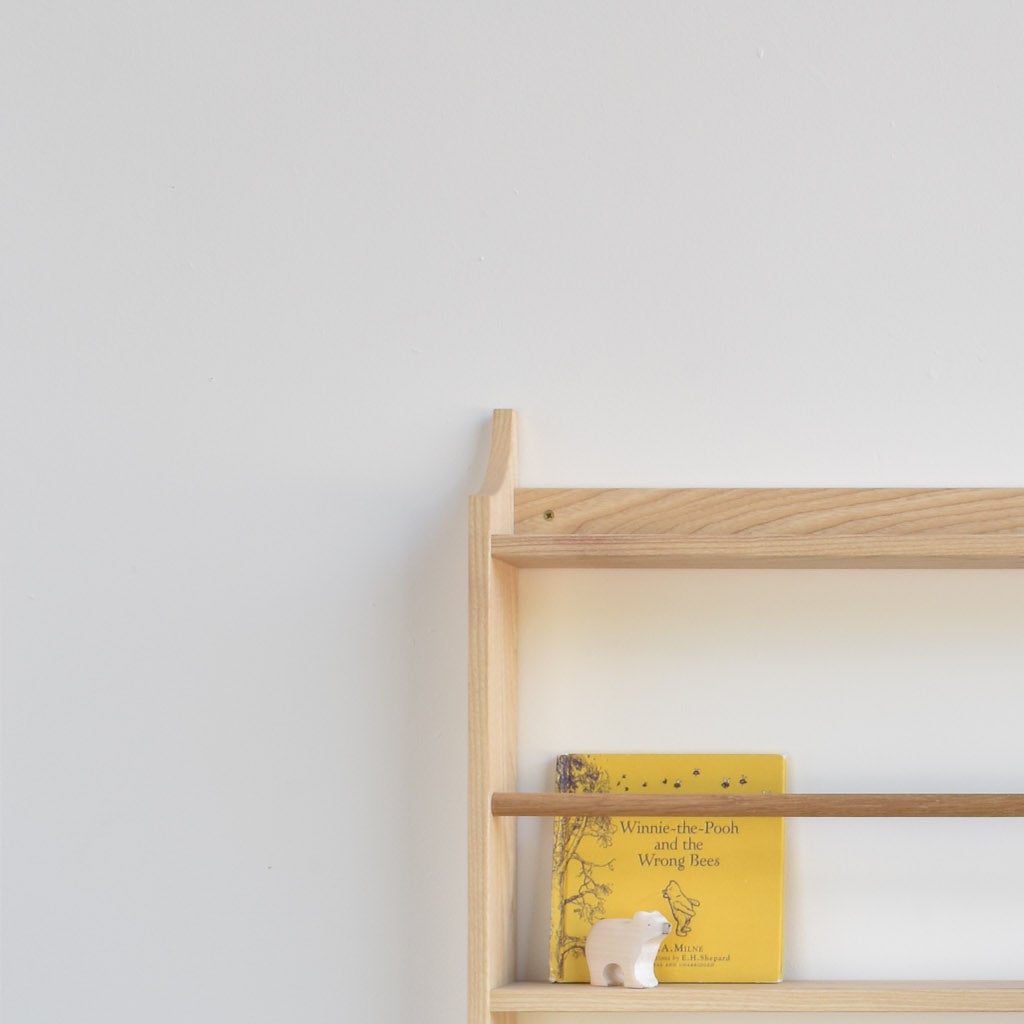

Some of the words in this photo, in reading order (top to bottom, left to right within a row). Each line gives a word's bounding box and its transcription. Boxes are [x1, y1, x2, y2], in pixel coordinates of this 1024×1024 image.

[620, 819, 739, 834] Winnie-the-Pooh
[654, 837, 678, 850] and
[683, 837, 704, 850] the
[638, 853, 685, 871] Wrong
[690, 853, 720, 867] Bees
